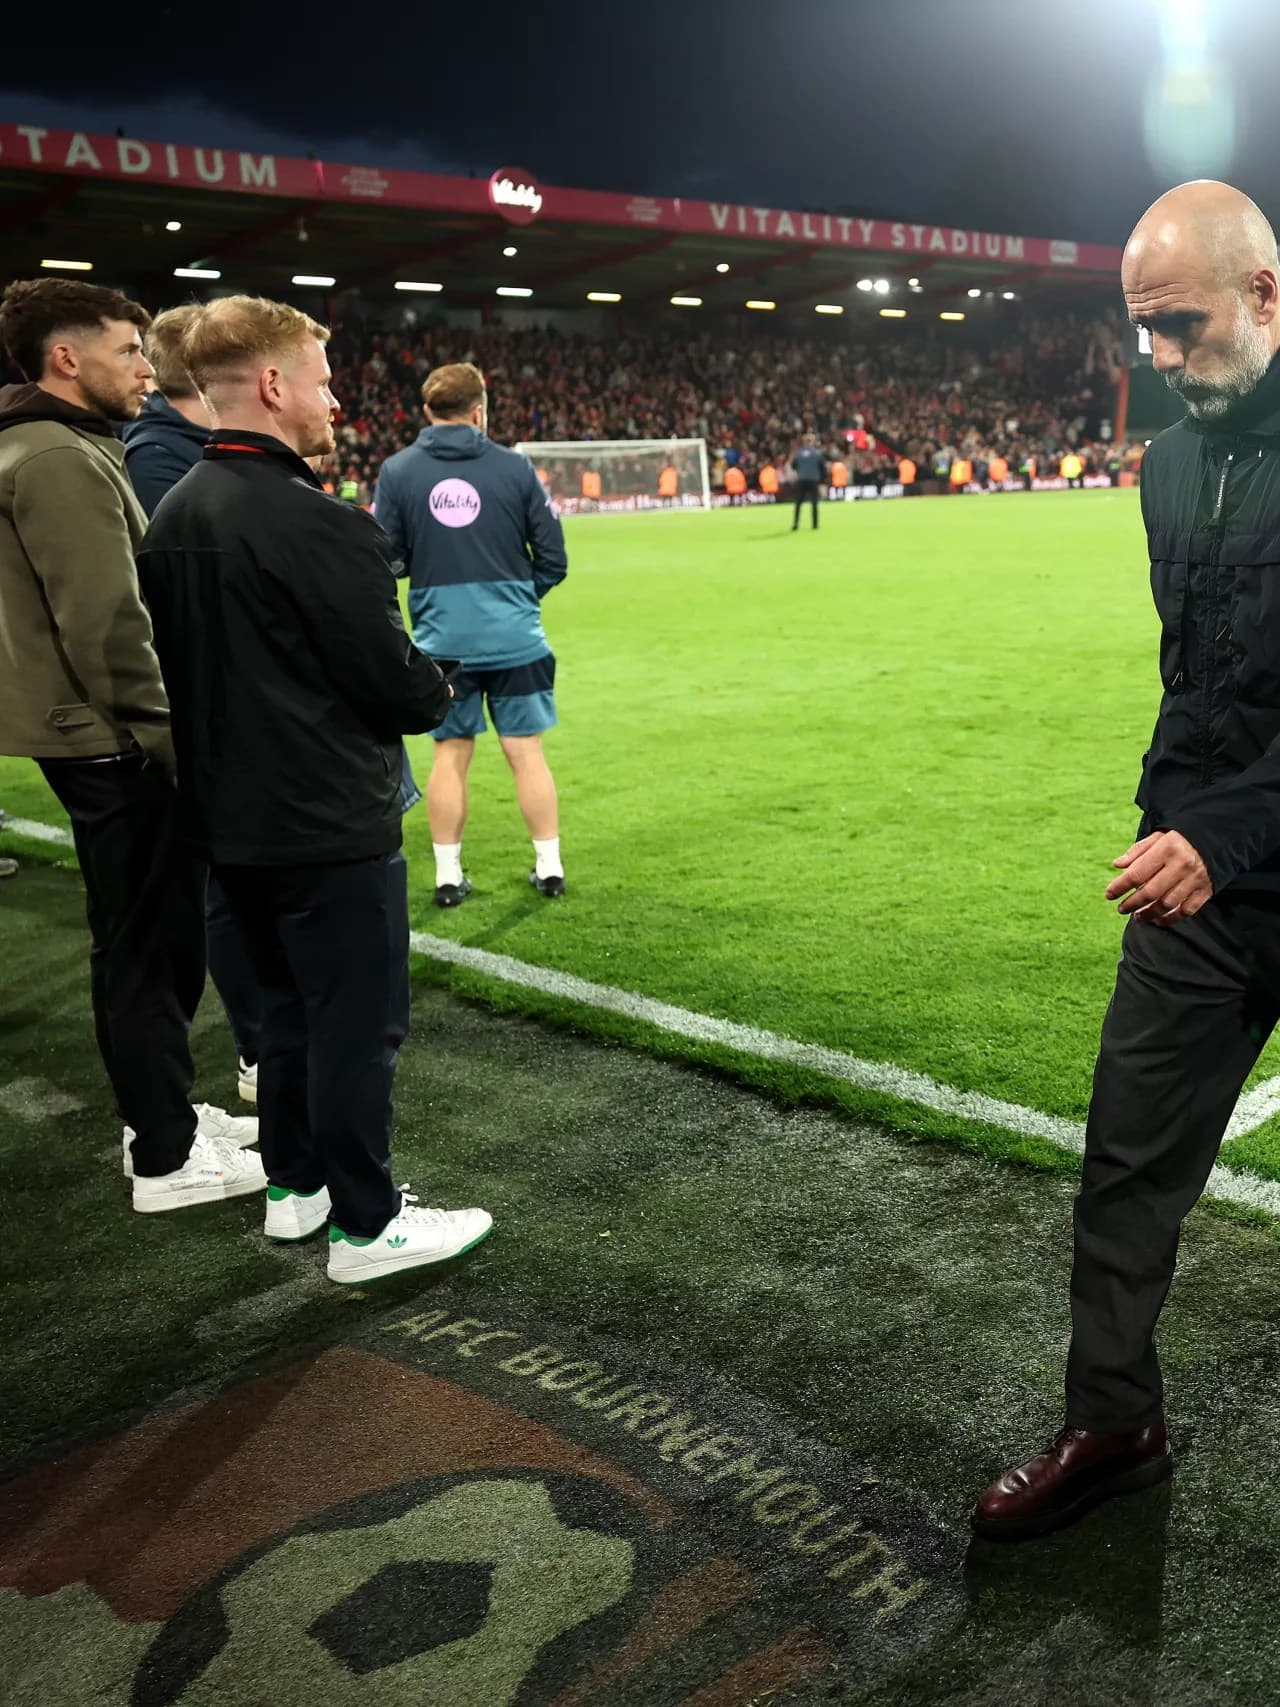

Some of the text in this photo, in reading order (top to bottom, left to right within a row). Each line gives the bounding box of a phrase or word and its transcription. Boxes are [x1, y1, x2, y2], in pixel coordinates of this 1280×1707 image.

[0, 124, 278, 189] TADIUM
[709, 203, 876, 244] VITALITY
[891, 223, 1025, 259] STADIUM
[432, 491, 478, 513] Vitality
[380, 1308, 928, 1621] AFC BOURNEMOUTH
